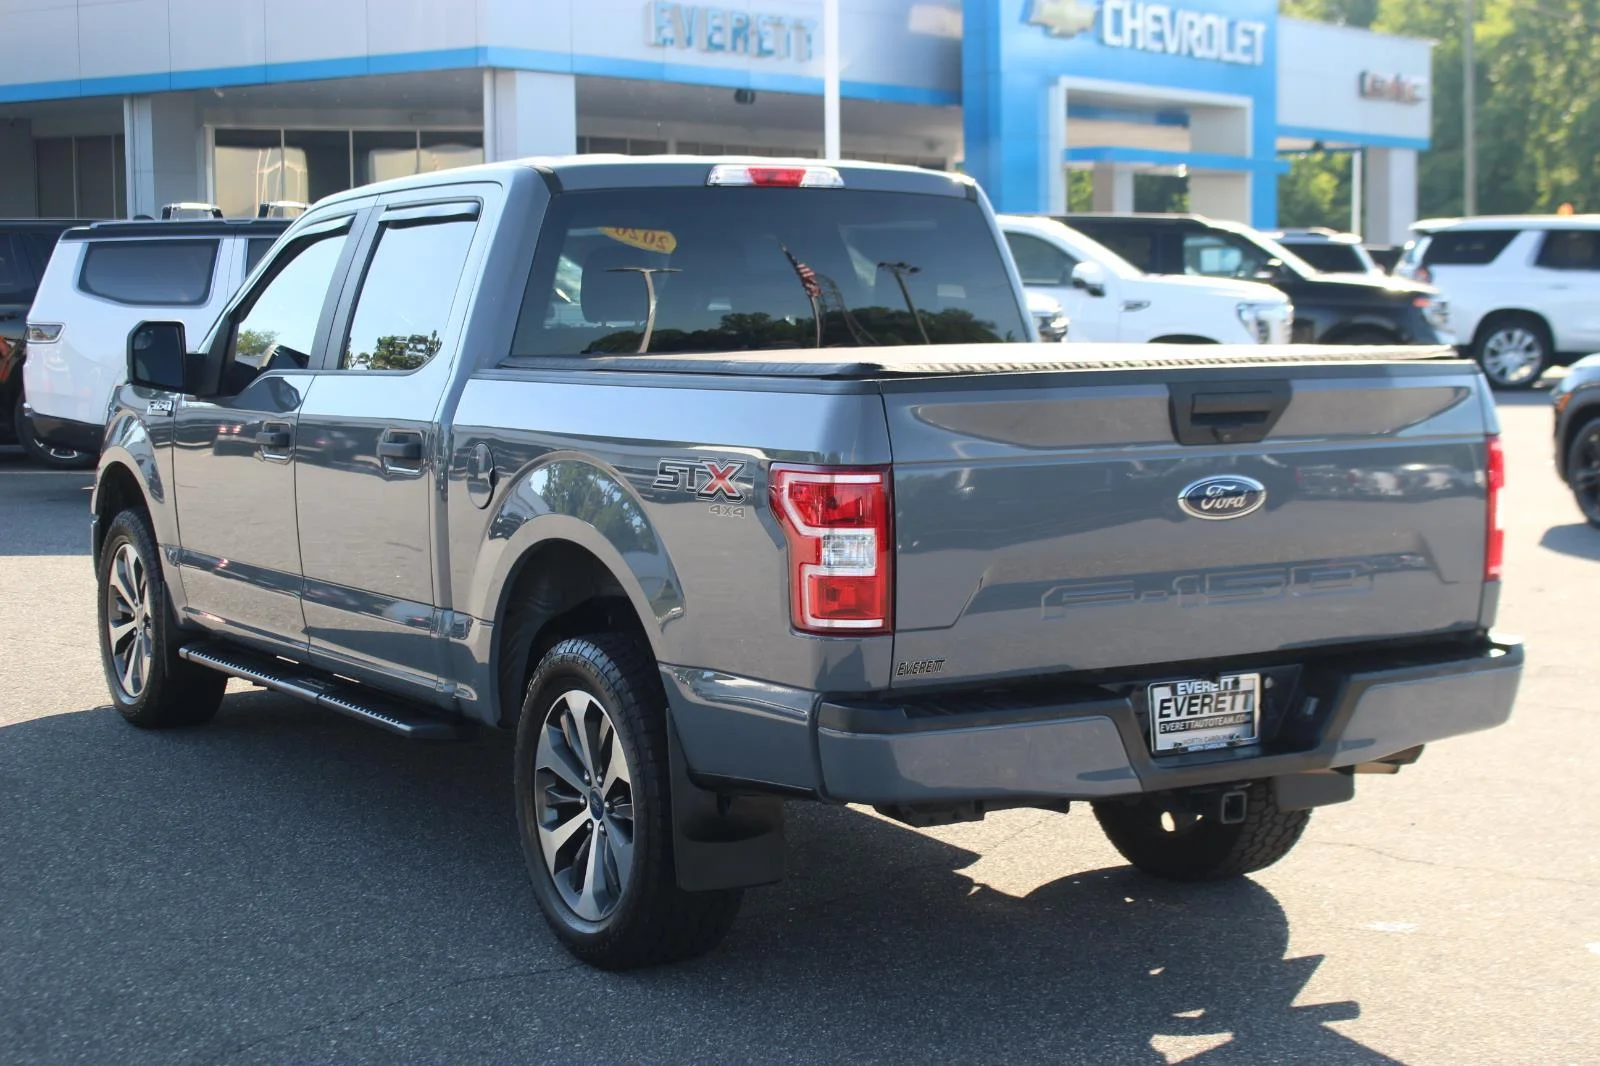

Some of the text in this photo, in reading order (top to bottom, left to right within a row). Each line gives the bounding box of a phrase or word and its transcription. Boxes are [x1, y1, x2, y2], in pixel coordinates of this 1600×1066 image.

[645, 1, 817, 62] EVERETT
[1102, 0, 1266, 66] CHEVROLET
[651, 457, 748, 504] STX
[1201, 484, 1248, 511] Ford
[896, 658, 946, 676] EVERETT
[1158, 692, 1250, 719] EVERETT
